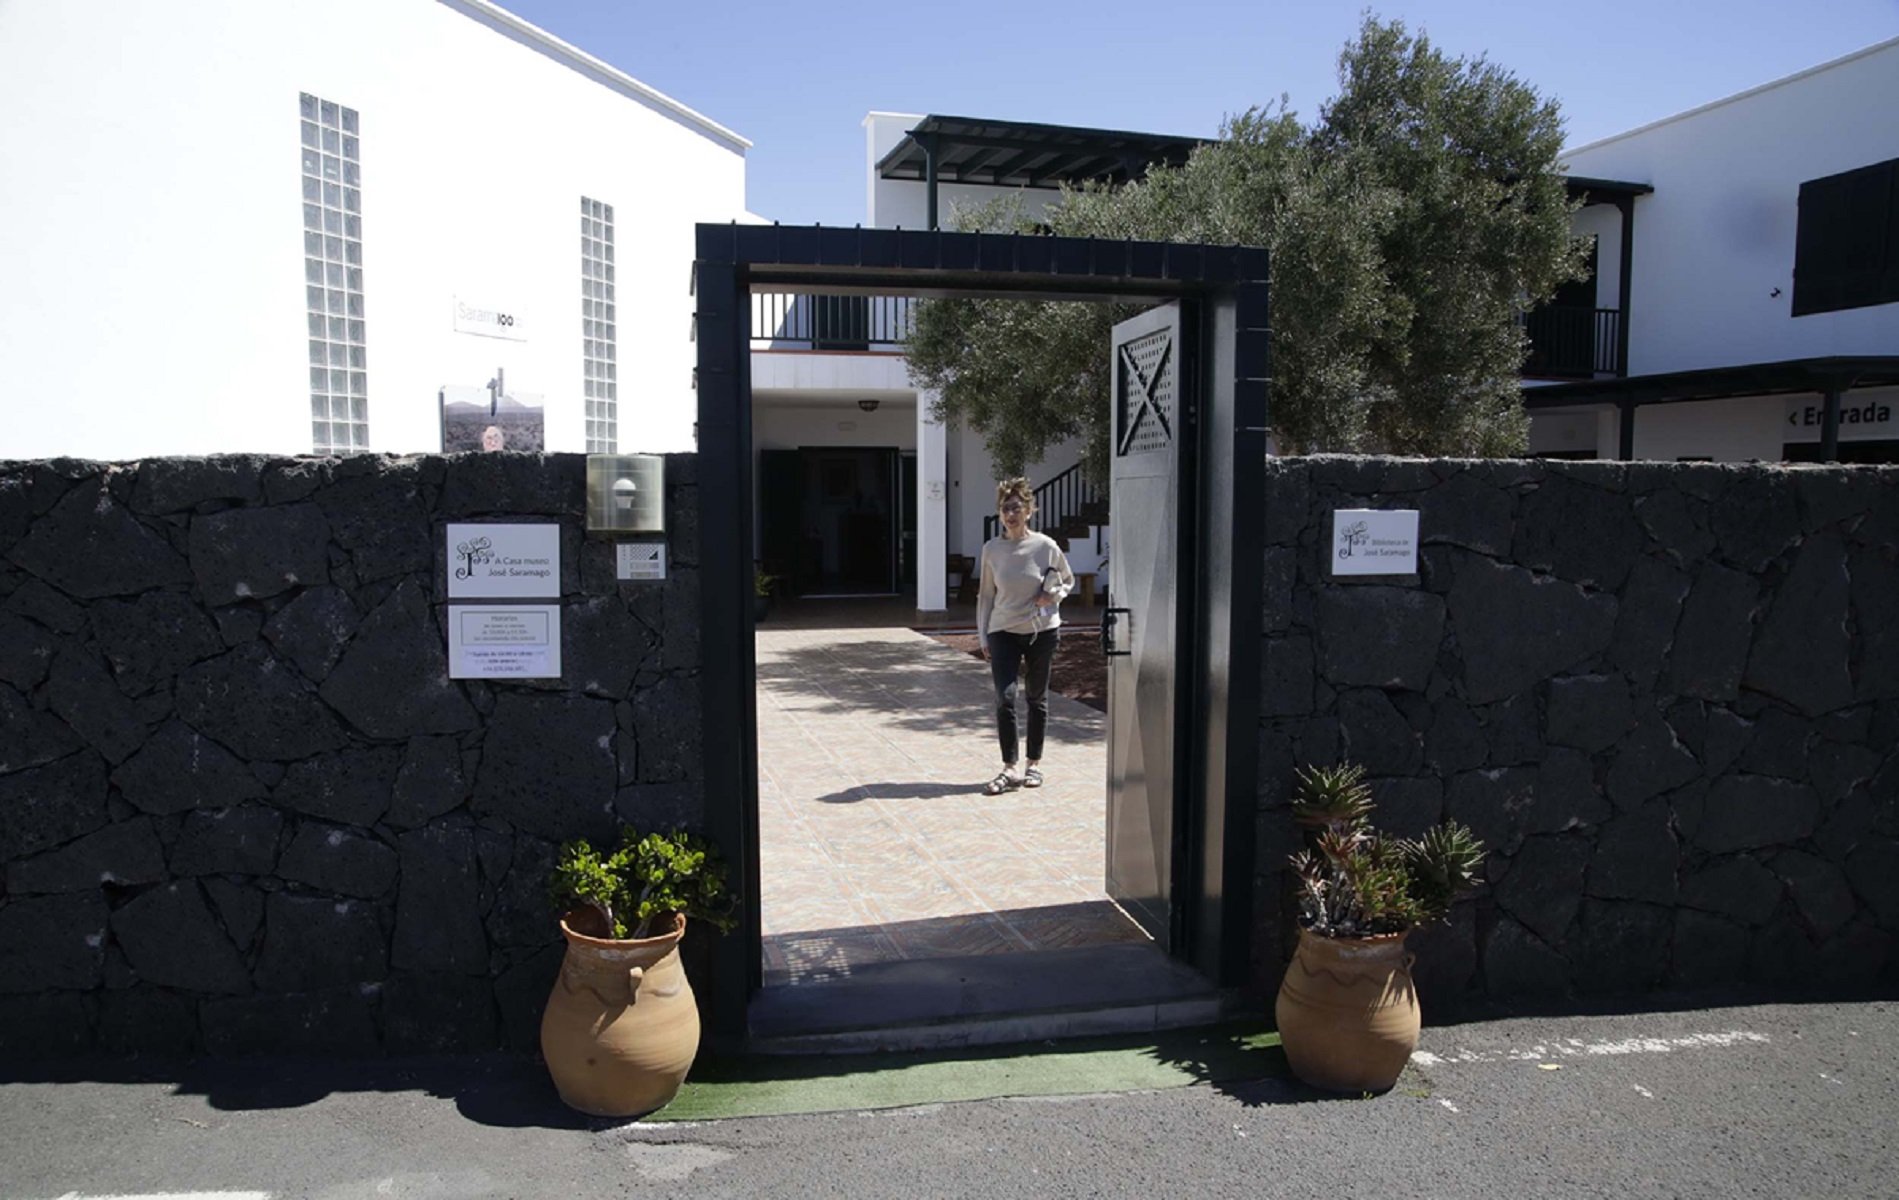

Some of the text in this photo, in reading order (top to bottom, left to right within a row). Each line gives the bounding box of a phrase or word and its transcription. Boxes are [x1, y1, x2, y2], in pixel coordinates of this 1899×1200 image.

[1804, 402, 1891, 425] Enrada
[503, 556, 522, 565] Casa
[488, 567, 551, 578] José Saramago
